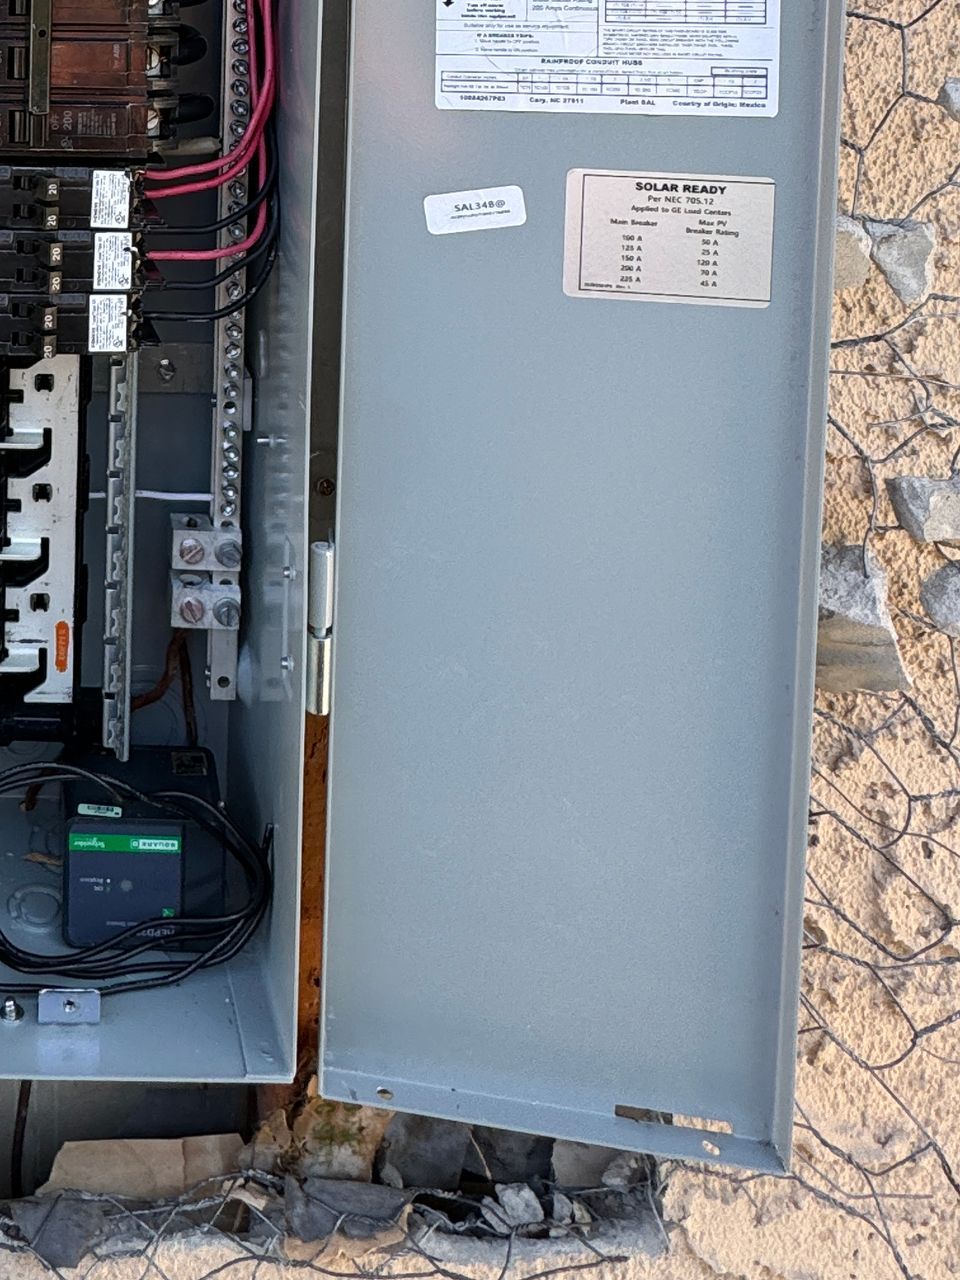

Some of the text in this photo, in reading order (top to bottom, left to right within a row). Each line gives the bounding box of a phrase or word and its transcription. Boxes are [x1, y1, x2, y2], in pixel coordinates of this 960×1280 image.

[63, 111, 72, 130] 200
[48, 184, 57, 195] 20
[635, 182, 727, 195] SOLAR READY
[648, 195, 714, 206] Per NEC 705.12
[631, 205, 659, 214] Applied
[684, 207, 702, 215] Load
[704, 209, 732, 217] Centers
[47, 215, 56, 227] 20
[610, 218, 658, 227] Main Breaker
[686, 227, 740, 238] Breaker Rating
[52, 247, 61, 261] 20
[51, 276, 60, 291] 20
[44, 315, 53, 328] 20
[44, 345, 53, 359] 20
